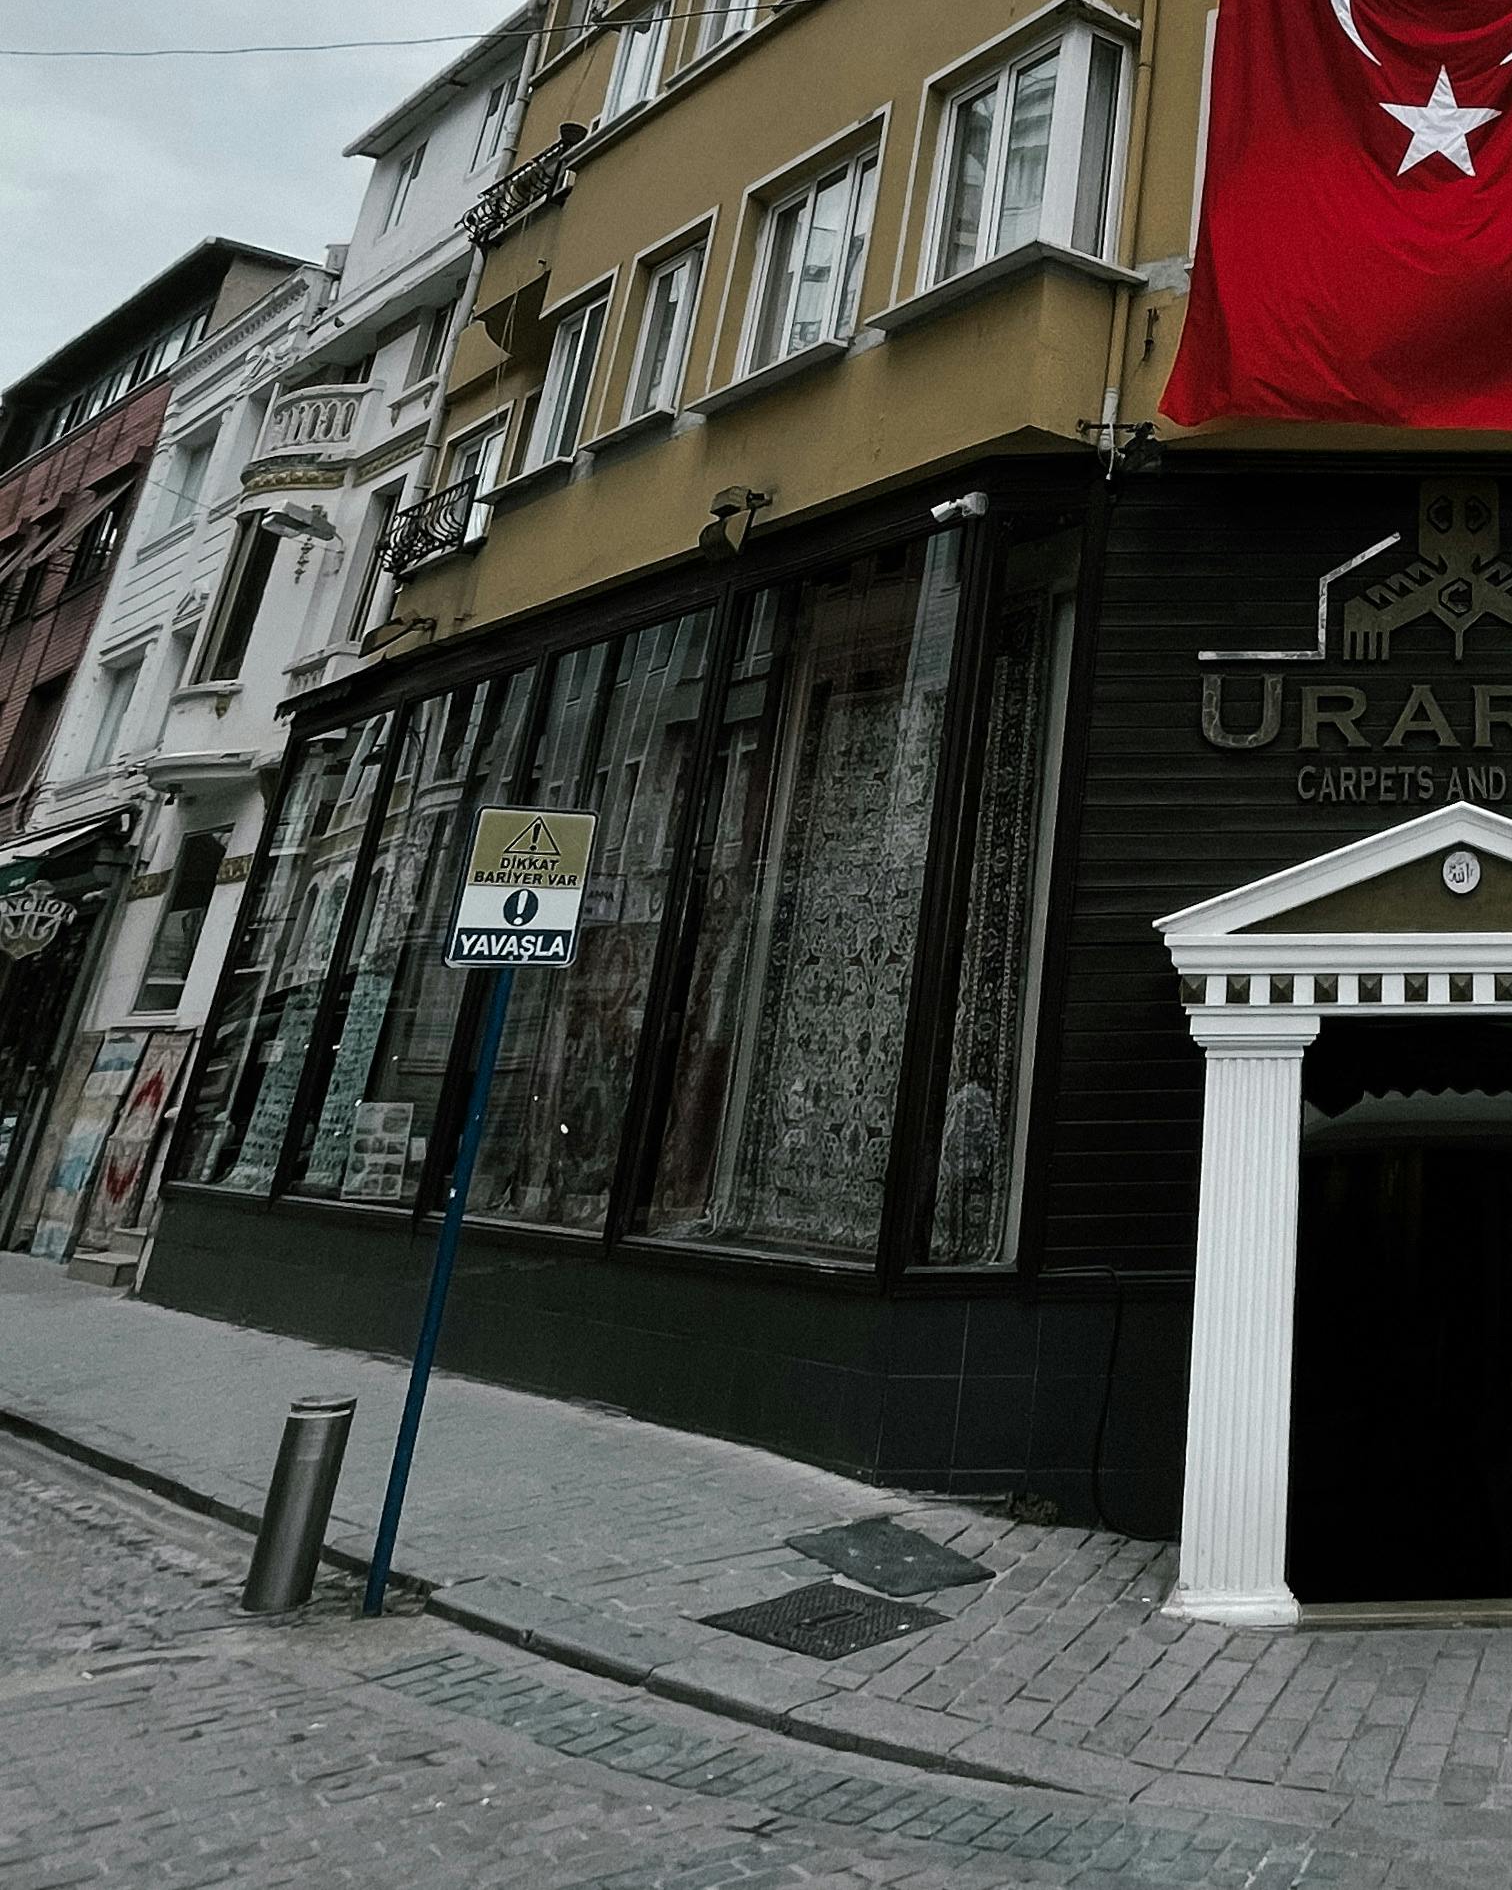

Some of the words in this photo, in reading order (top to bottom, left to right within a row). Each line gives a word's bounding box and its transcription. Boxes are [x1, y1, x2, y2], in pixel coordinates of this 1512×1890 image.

[1297, 764, 1434, 802] CARPETS
[1446, 765, 1507, 801] AND
[500, 856, 559, 871] DİKKAT
[473, 869, 543, 886] BARİYER
[548, 873, 578, 887] VAR
[0, 897, 74, 920] NCHOR
[460, 933, 565, 960] YAVAŞLA
